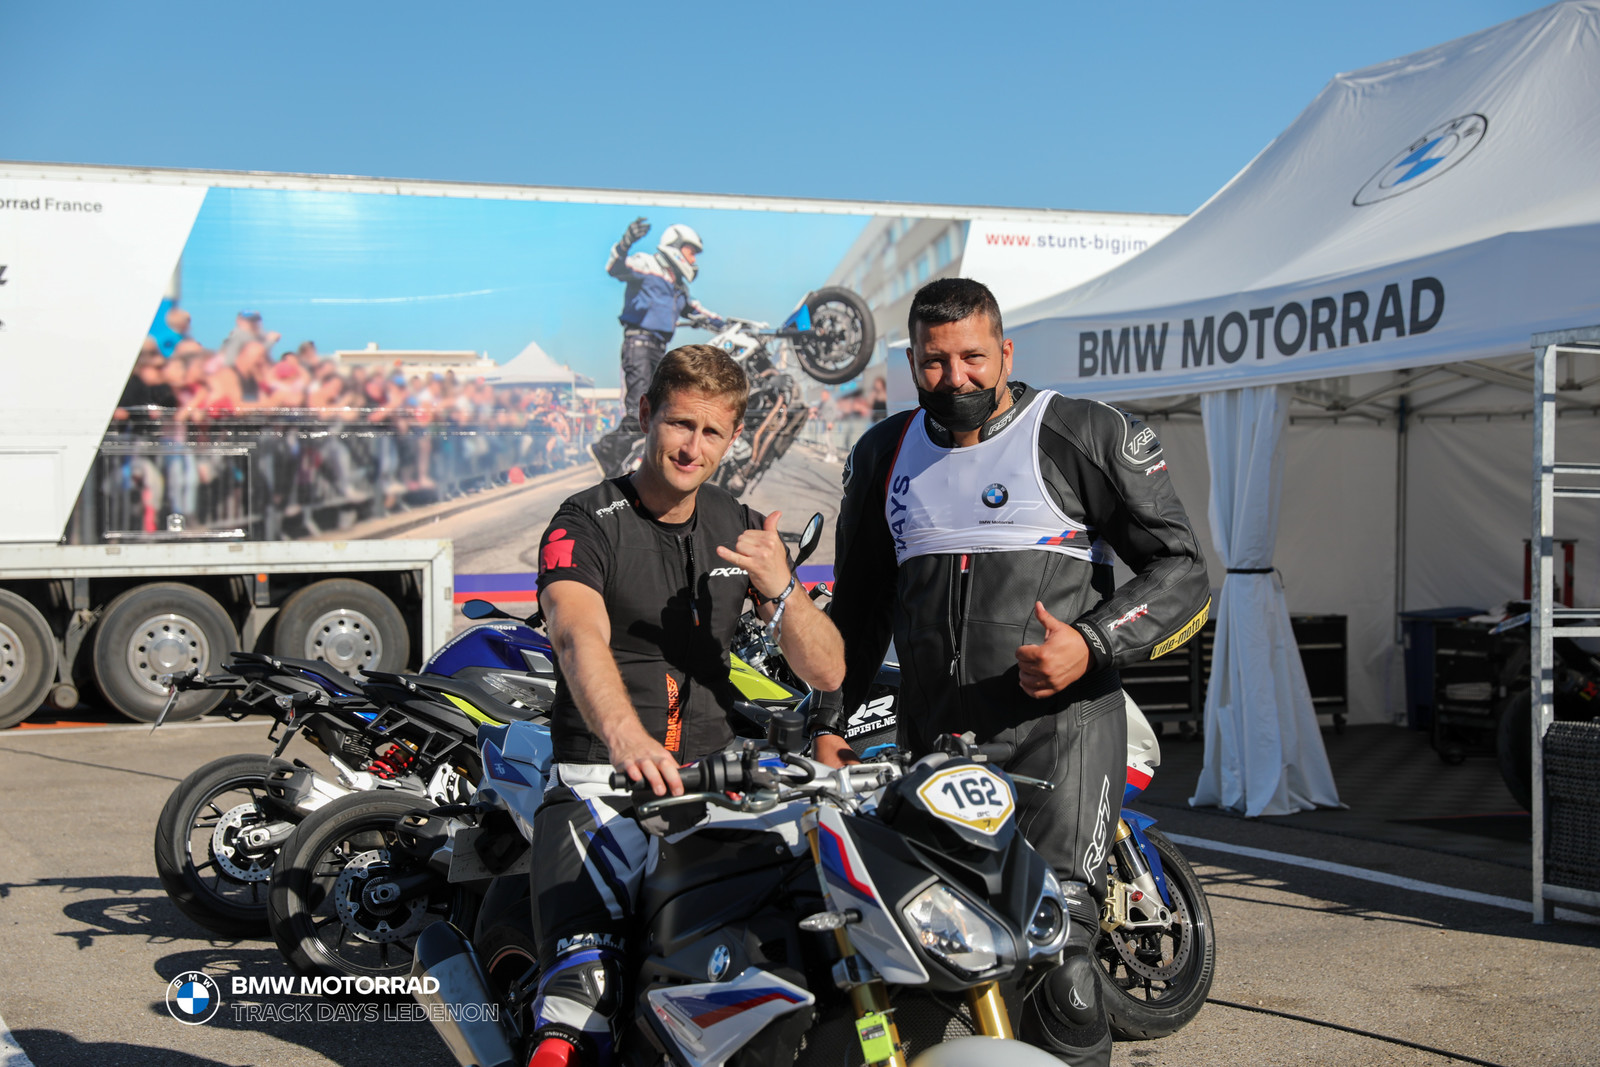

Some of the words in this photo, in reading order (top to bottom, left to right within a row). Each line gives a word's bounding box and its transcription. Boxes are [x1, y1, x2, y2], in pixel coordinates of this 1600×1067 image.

[45, 198, 103, 213] France
[1078, 320, 1169, 378] BMW
[1181, 276, 1446, 370] MOTORRAD
[941, 777, 1003, 809] 162
